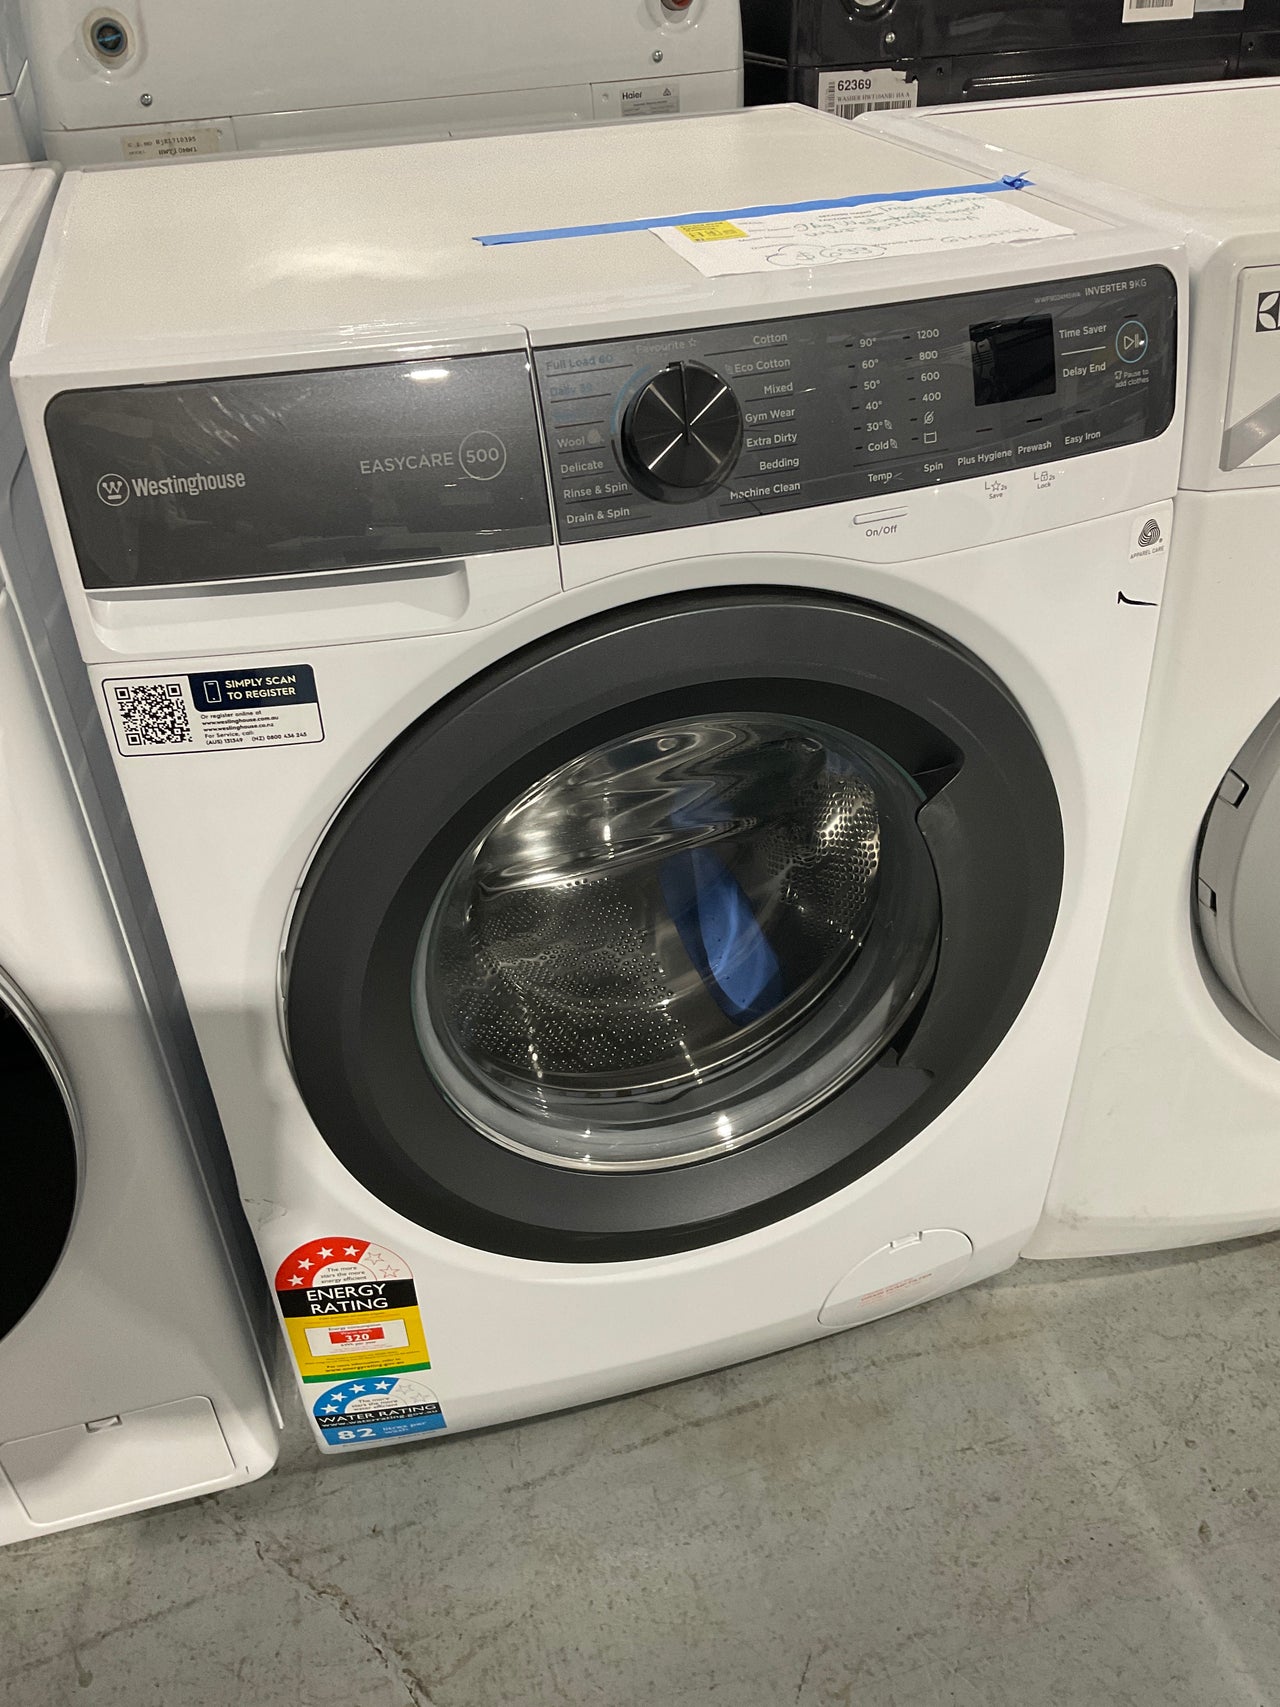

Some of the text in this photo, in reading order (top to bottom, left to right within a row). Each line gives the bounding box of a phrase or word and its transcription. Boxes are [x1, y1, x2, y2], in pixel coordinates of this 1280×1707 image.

[838, 79, 871, 91] 62369
[622, 91, 642, 100] Haier
[1085, 281, 1127, 297] INVERTER
[1129, 278, 1147, 290] 9KG
[917, 328, 940, 340] 1200
[1059, 324, 1107, 339] Time Saver
[753, 333, 788, 345] Cotton
[919, 350, 938, 361] 800
[545, 359, 566, 371] Full
[568, 355, 596, 368] Load
[734, 359, 791, 373] Eco Cotton
[921, 371, 940, 382] 600
[1062, 362, 1106, 378] Delay End
[1124, 369, 1141, 378] Pause
[763, 382, 793, 394] Mixed
[1115, 377, 1150, 388] add clothes
[922, 391, 942, 402] 400
[745, 409, 795, 424] Gym Wear
[556, 436, 585, 449] Wool
[746, 432, 798, 447] Extra Dirty
[1065, 431, 1101, 446] Easy Iron
[868, 440, 889, 452] Cold
[1017, 440, 1052, 454] Prewash
[360, 447, 500, 475] EASYCARE 500
[957, 449, 1013, 466] Plus Hygiene
[560, 460, 604, 474] Delicate
[759, 458, 800, 471] Bedding
[924, 462, 943, 473] Spin
[131, 471, 246, 497] Westinghouse
[868, 472, 893, 483] Temp
[563, 482, 628, 499] Rinse & Spin
[730, 482, 800, 500] Machine Clean
[1037, 482, 1051, 490] Lock
[989, 492, 1003, 500] Save
[566, 507, 630, 524] Drain & Spin
[865, 525, 898, 538] On/Off
[1129, 545, 1165, 560] APPAREL CARE
[225, 674, 297, 689] SIMPLY SCAN
[226, 686, 297, 700] TO REGISTER
[202, 715, 279, 726] www.westinghouse.com.au
[210, 712, 234, 720] register
[203, 722, 274, 732] www.westinghouse.co.nz
[306, 1283, 386, 1302] ENERGY
[310, 1297, 388, 1314] RATING
[345, 1333, 370, 1342] 320
[319, 1404, 437, 1423] WATER RATING
[338, 1428, 376, 1440] 82
